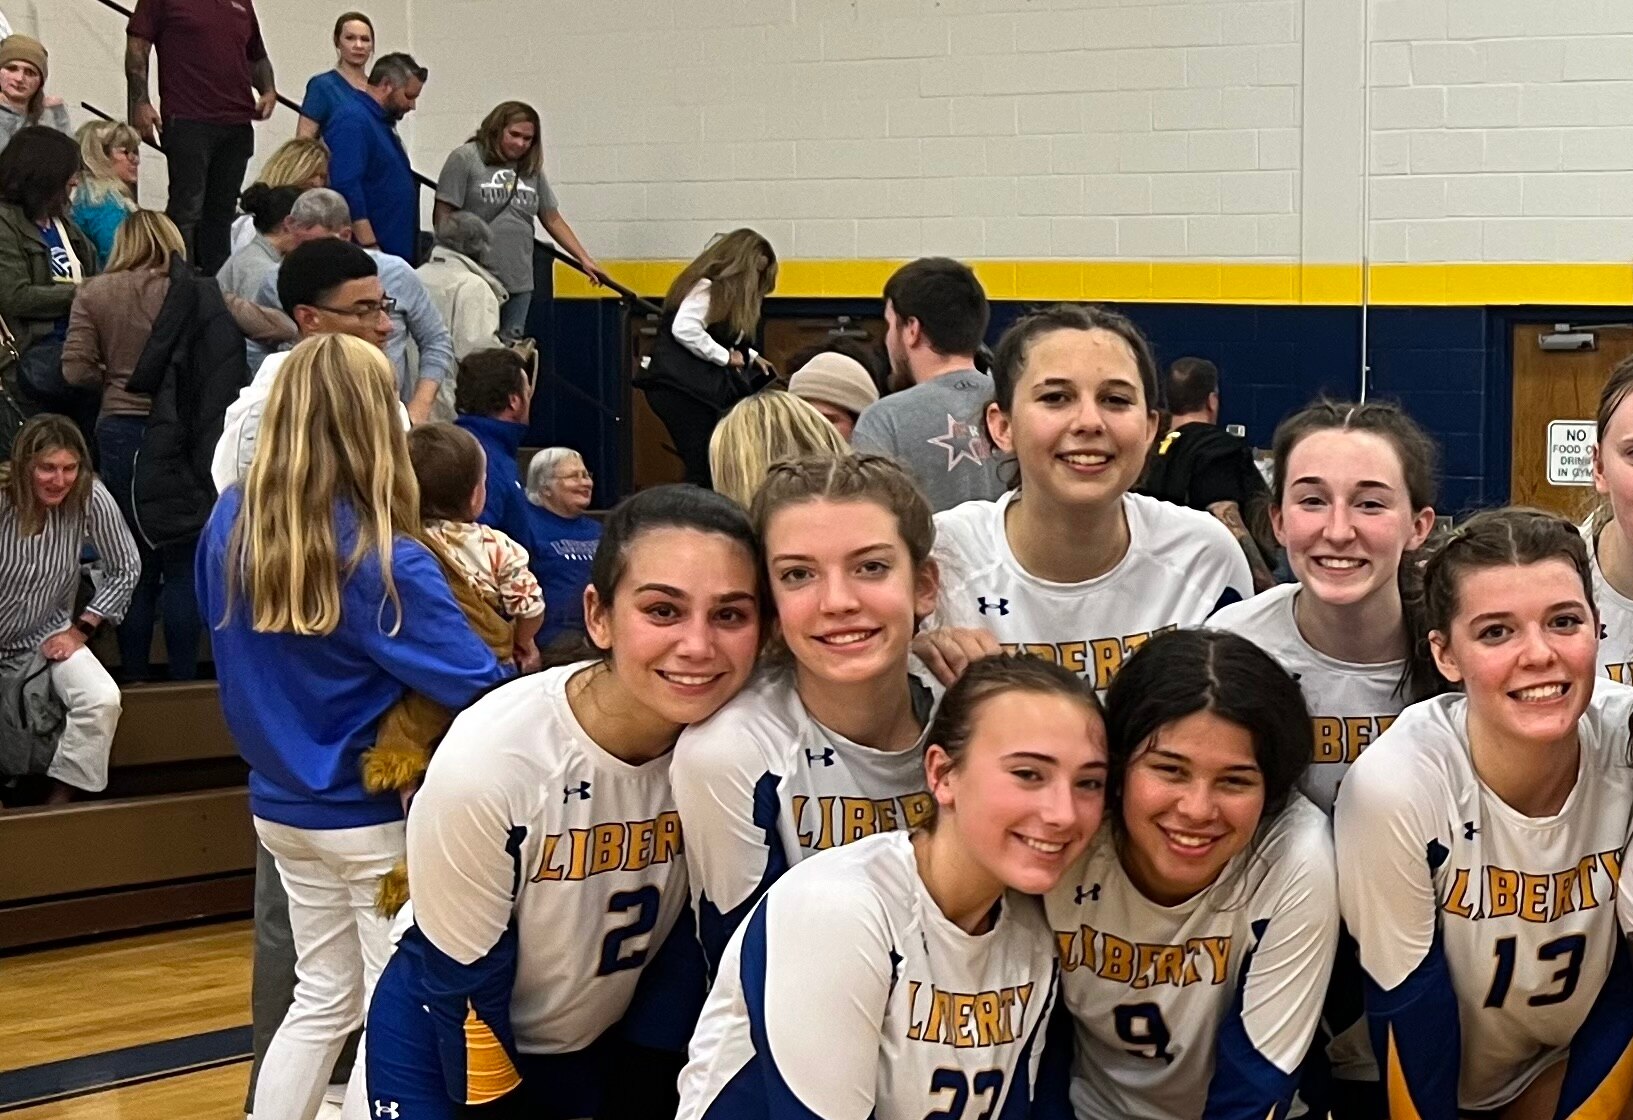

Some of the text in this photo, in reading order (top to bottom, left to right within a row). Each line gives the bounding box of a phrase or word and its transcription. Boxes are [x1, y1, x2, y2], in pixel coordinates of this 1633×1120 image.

[1553, 444, 1581, 454] FOOD
[1566, 429, 1586, 441] NO
[1558, 468, 1568, 476] IN
[530, 810, 685, 883] LIBER
[792, 790, 938, 850] LIBER
[597, 885, 660, 976] 2
[1483, 935, 1587, 1008] 13
[1113, 1002, 1176, 1066] 9
